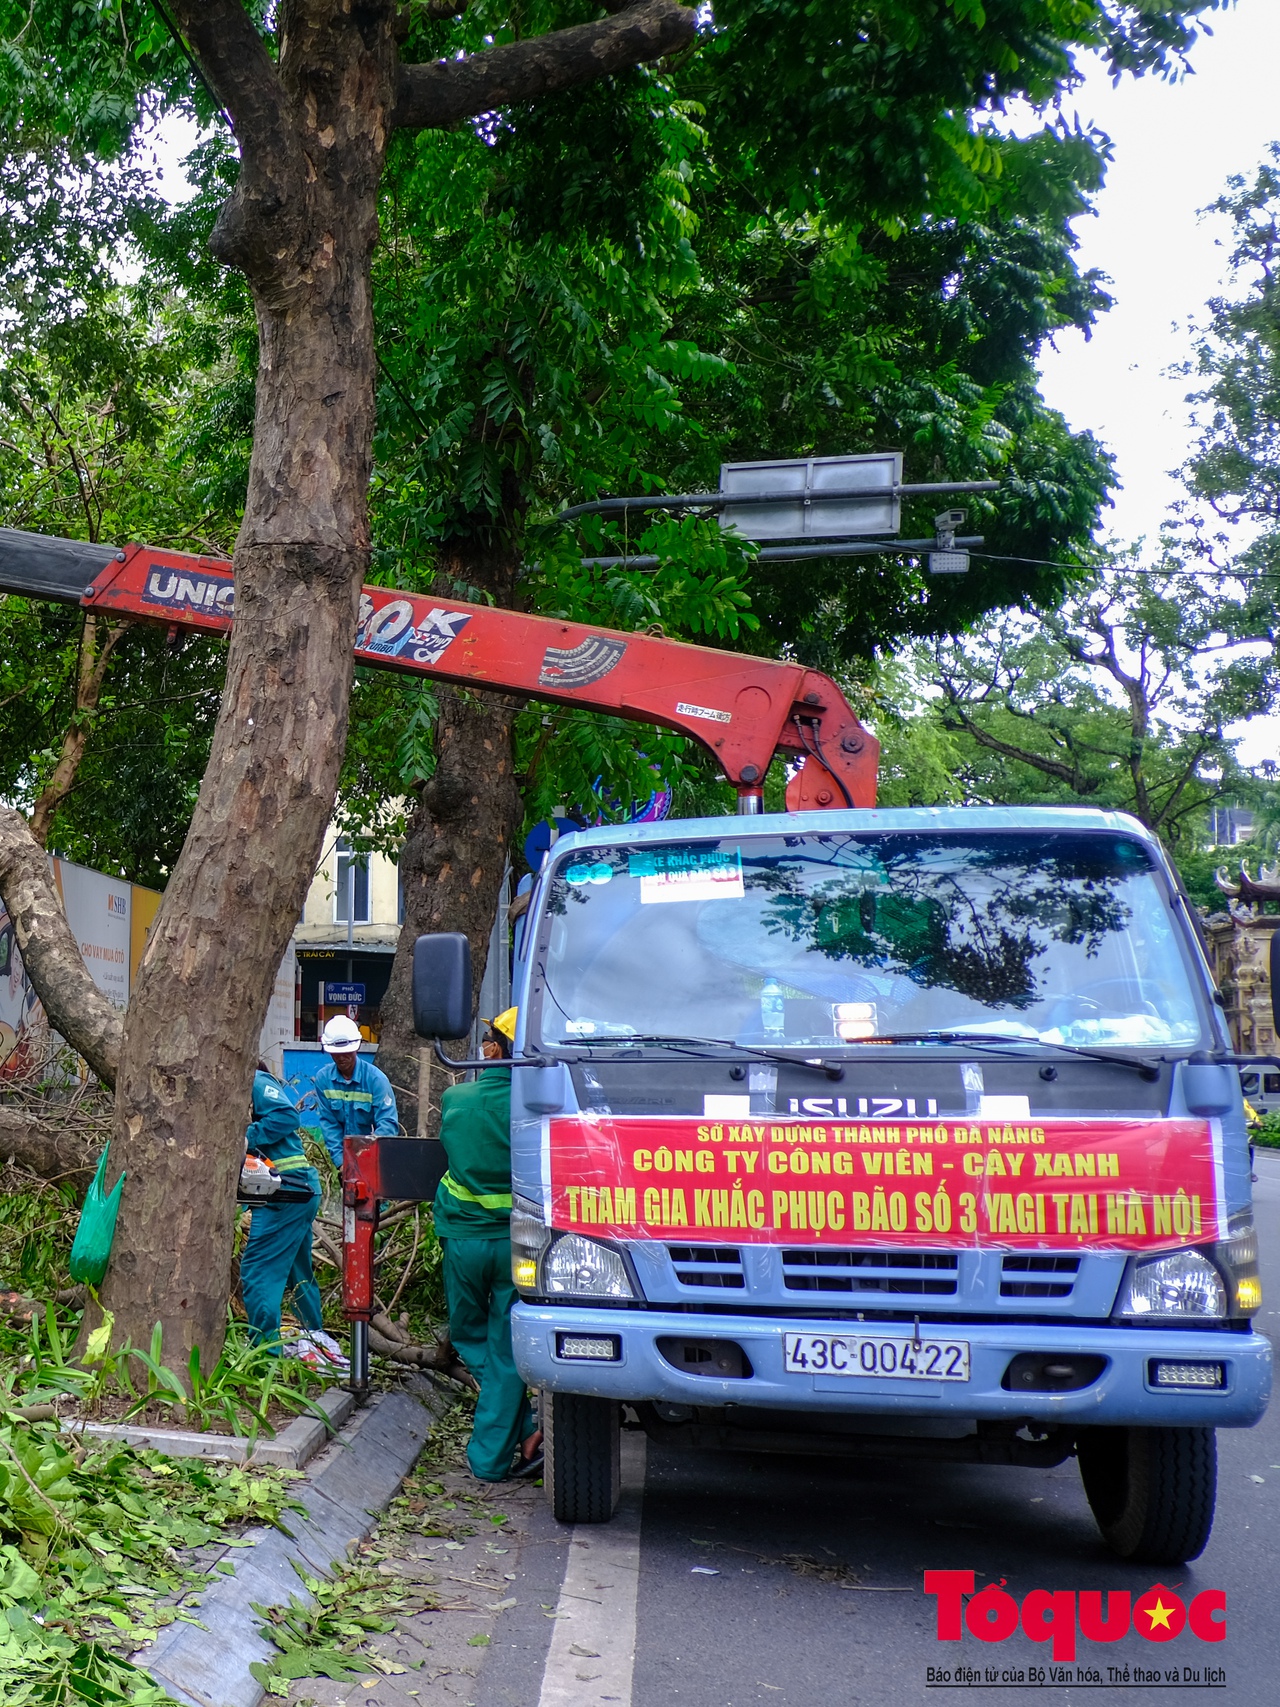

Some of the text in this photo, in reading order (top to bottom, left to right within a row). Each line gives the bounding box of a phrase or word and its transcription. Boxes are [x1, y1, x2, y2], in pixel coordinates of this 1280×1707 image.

[666, 850, 697, 867] KHẮC
[700, 851, 731, 866] PHỤC
[114, 895, 127, 915] SHB
[81, 942, 92, 957] CHO
[92, 945, 103, 960] VAY
[328, 991, 363, 1002] VỌNG ĐỨC
[788, 1097, 939, 1118] ISUZU
[696, 1123, 1045, 1147] SỞ XÂY DỰNG THÀNH PHỐ ĐÀ NẴNG
[633, 1146, 715, 1173] CÔNG
[724, 1150, 760, 1173] TY
[767, 1147, 854, 1175] CÔNG
[862, 1147, 934, 1176] VIÊN
[964, 1149, 1025, 1177] CÂY
[1034, 1152, 1120, 1177] XANH
[565, 1178, 1203, 1244] THAM GIA KHẮC PHỤC BÃO SỐ 3 YAGI TẠI HÀ NỘI
